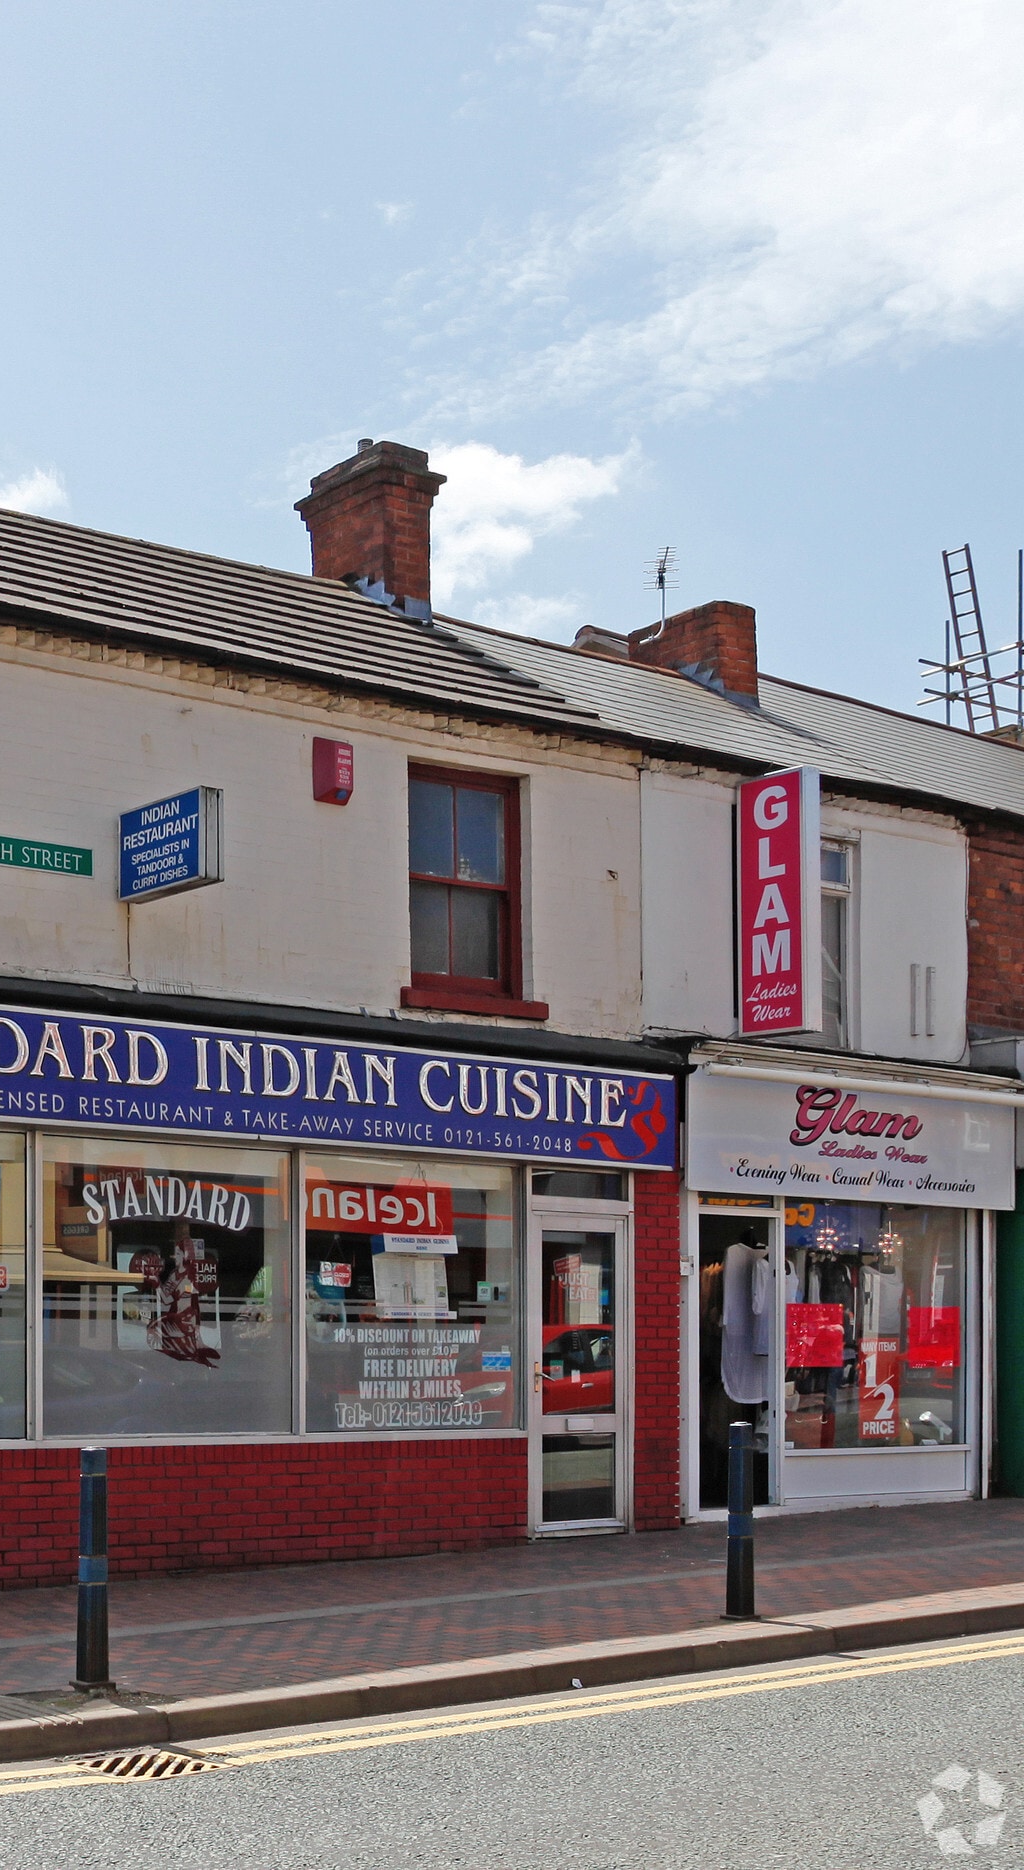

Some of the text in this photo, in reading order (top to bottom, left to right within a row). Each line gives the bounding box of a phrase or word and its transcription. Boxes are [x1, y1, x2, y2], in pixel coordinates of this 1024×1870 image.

[141, 800, 180, 826] INDIAN
[123, 813, 198, 851] RESTAURANT
[21, 846, 83, 872] STREET
[131, 838, 190, 866] SPECIALISTS IN
[137, 854, 184, 876] TANDOORI &
[132, 865, 188, 891] CURRY DISHES
[752, 785, 791, 977] GLAM
[746, 982, 798, 1003] Ladies
[751, 1004, 792, 1022] Wear
[192, 1036, 398, 1107] INDIAN
[418, 1060, 628, 1128] CUISINE
[79, 1096, 214, 1124] RESTAURANT
[223, 1110, 234, 1126] &
[363, 1119, 433, 1141] SERVICE
[444, 1128, 572, 1152] 0121-561-2048
[789, 1083, 925, 1147] Glam
[818, 1141, 929, 1165] Ladies Wear
[736, 1158, 976, 1194] Evening Wear Casual Wear Accessories
[82, 1176, 251, 1232] STANDARD
[333, 1329, 480, 1344] 10% DISCOUNT ON TAKEAWAY
[861, 1341, 896, 1351] MANY ITEMS
[364, 1345, 380, 1358] (on
[381, 1345, 409, 1356] orders
[412, 1347, 430, 1356] over
[364, 1359, 457, 1378] FREE DELIVERY
[359, 1380, 461, 1399] WITHIN 3 MILES
[862, 1421, 895, 1435] PRICE
